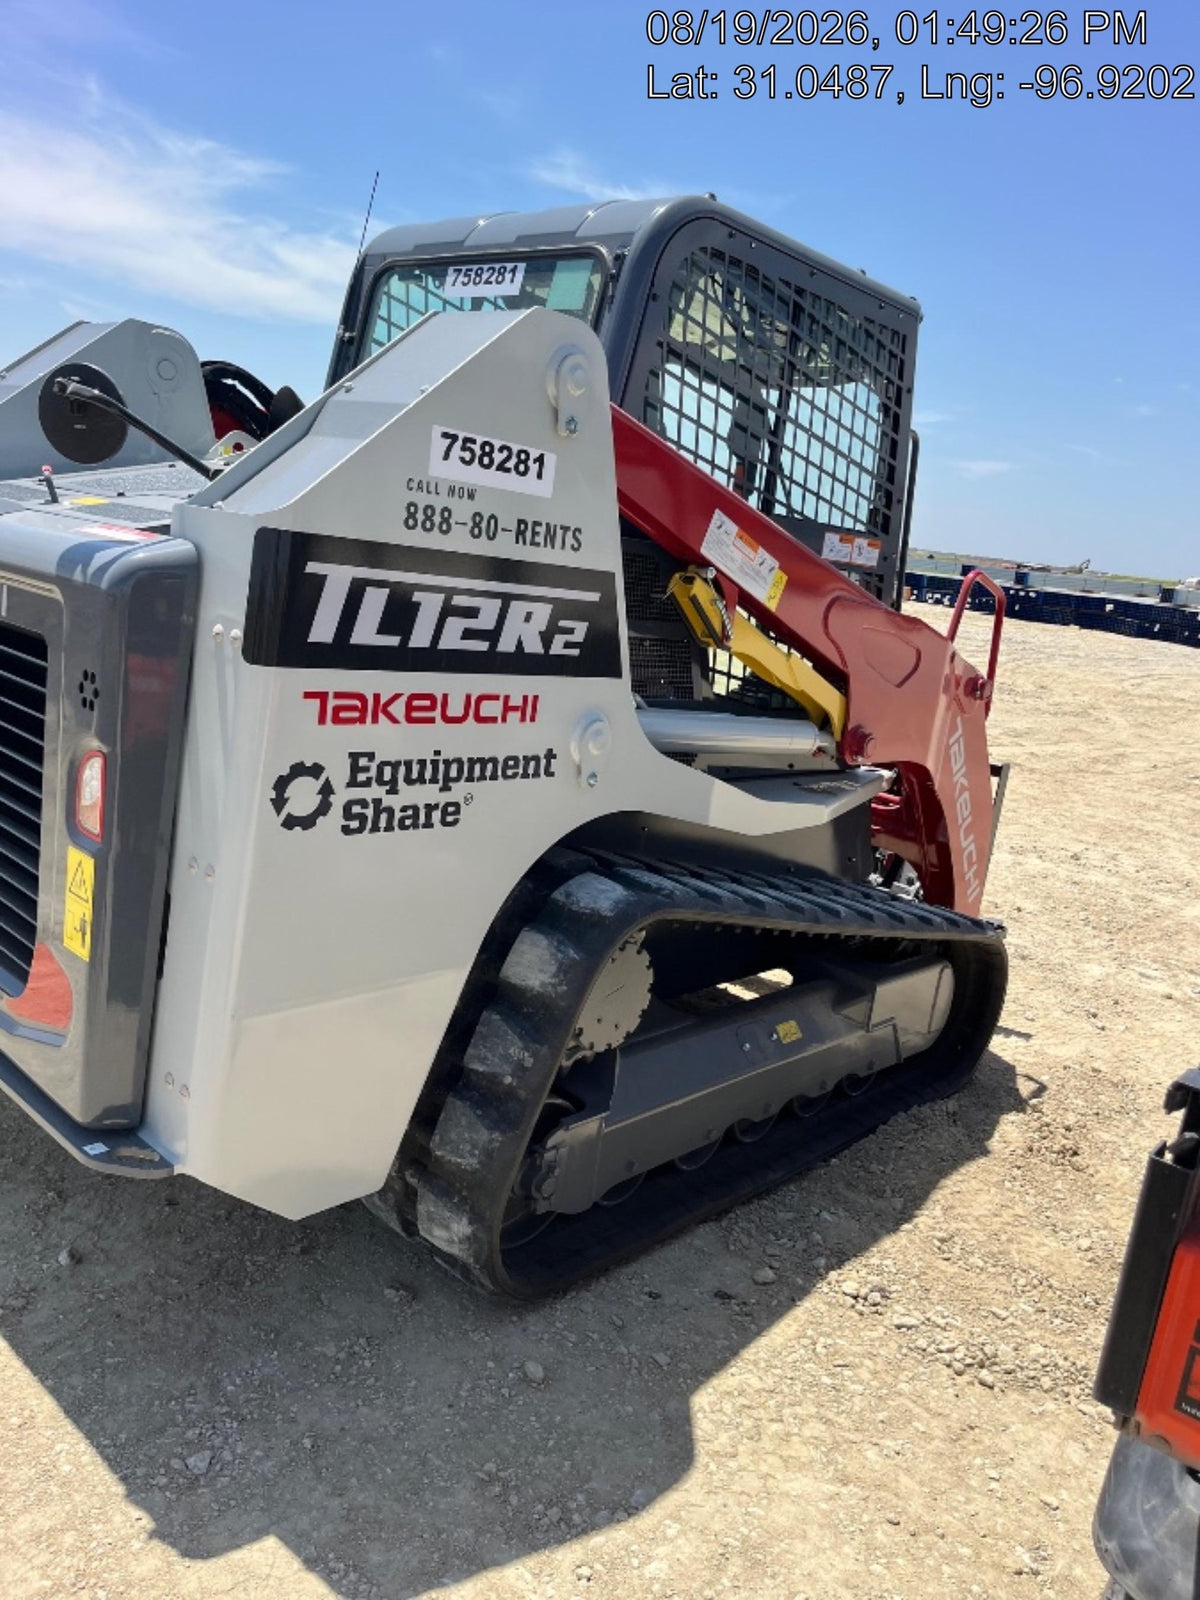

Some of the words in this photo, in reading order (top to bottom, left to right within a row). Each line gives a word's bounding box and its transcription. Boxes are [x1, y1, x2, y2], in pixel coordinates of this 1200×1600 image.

[451, 264, 519, 287] 758281
[440, 431, 546, 480] 758281
[406, 477, 441, 497] CALL
[447, 484, 478, 502] NOW
[403, 501, 583, 553] 888-80-RENTS
[305, 561, 601, 656] TL12R2
[345, 747, 557, 796] Equipment
